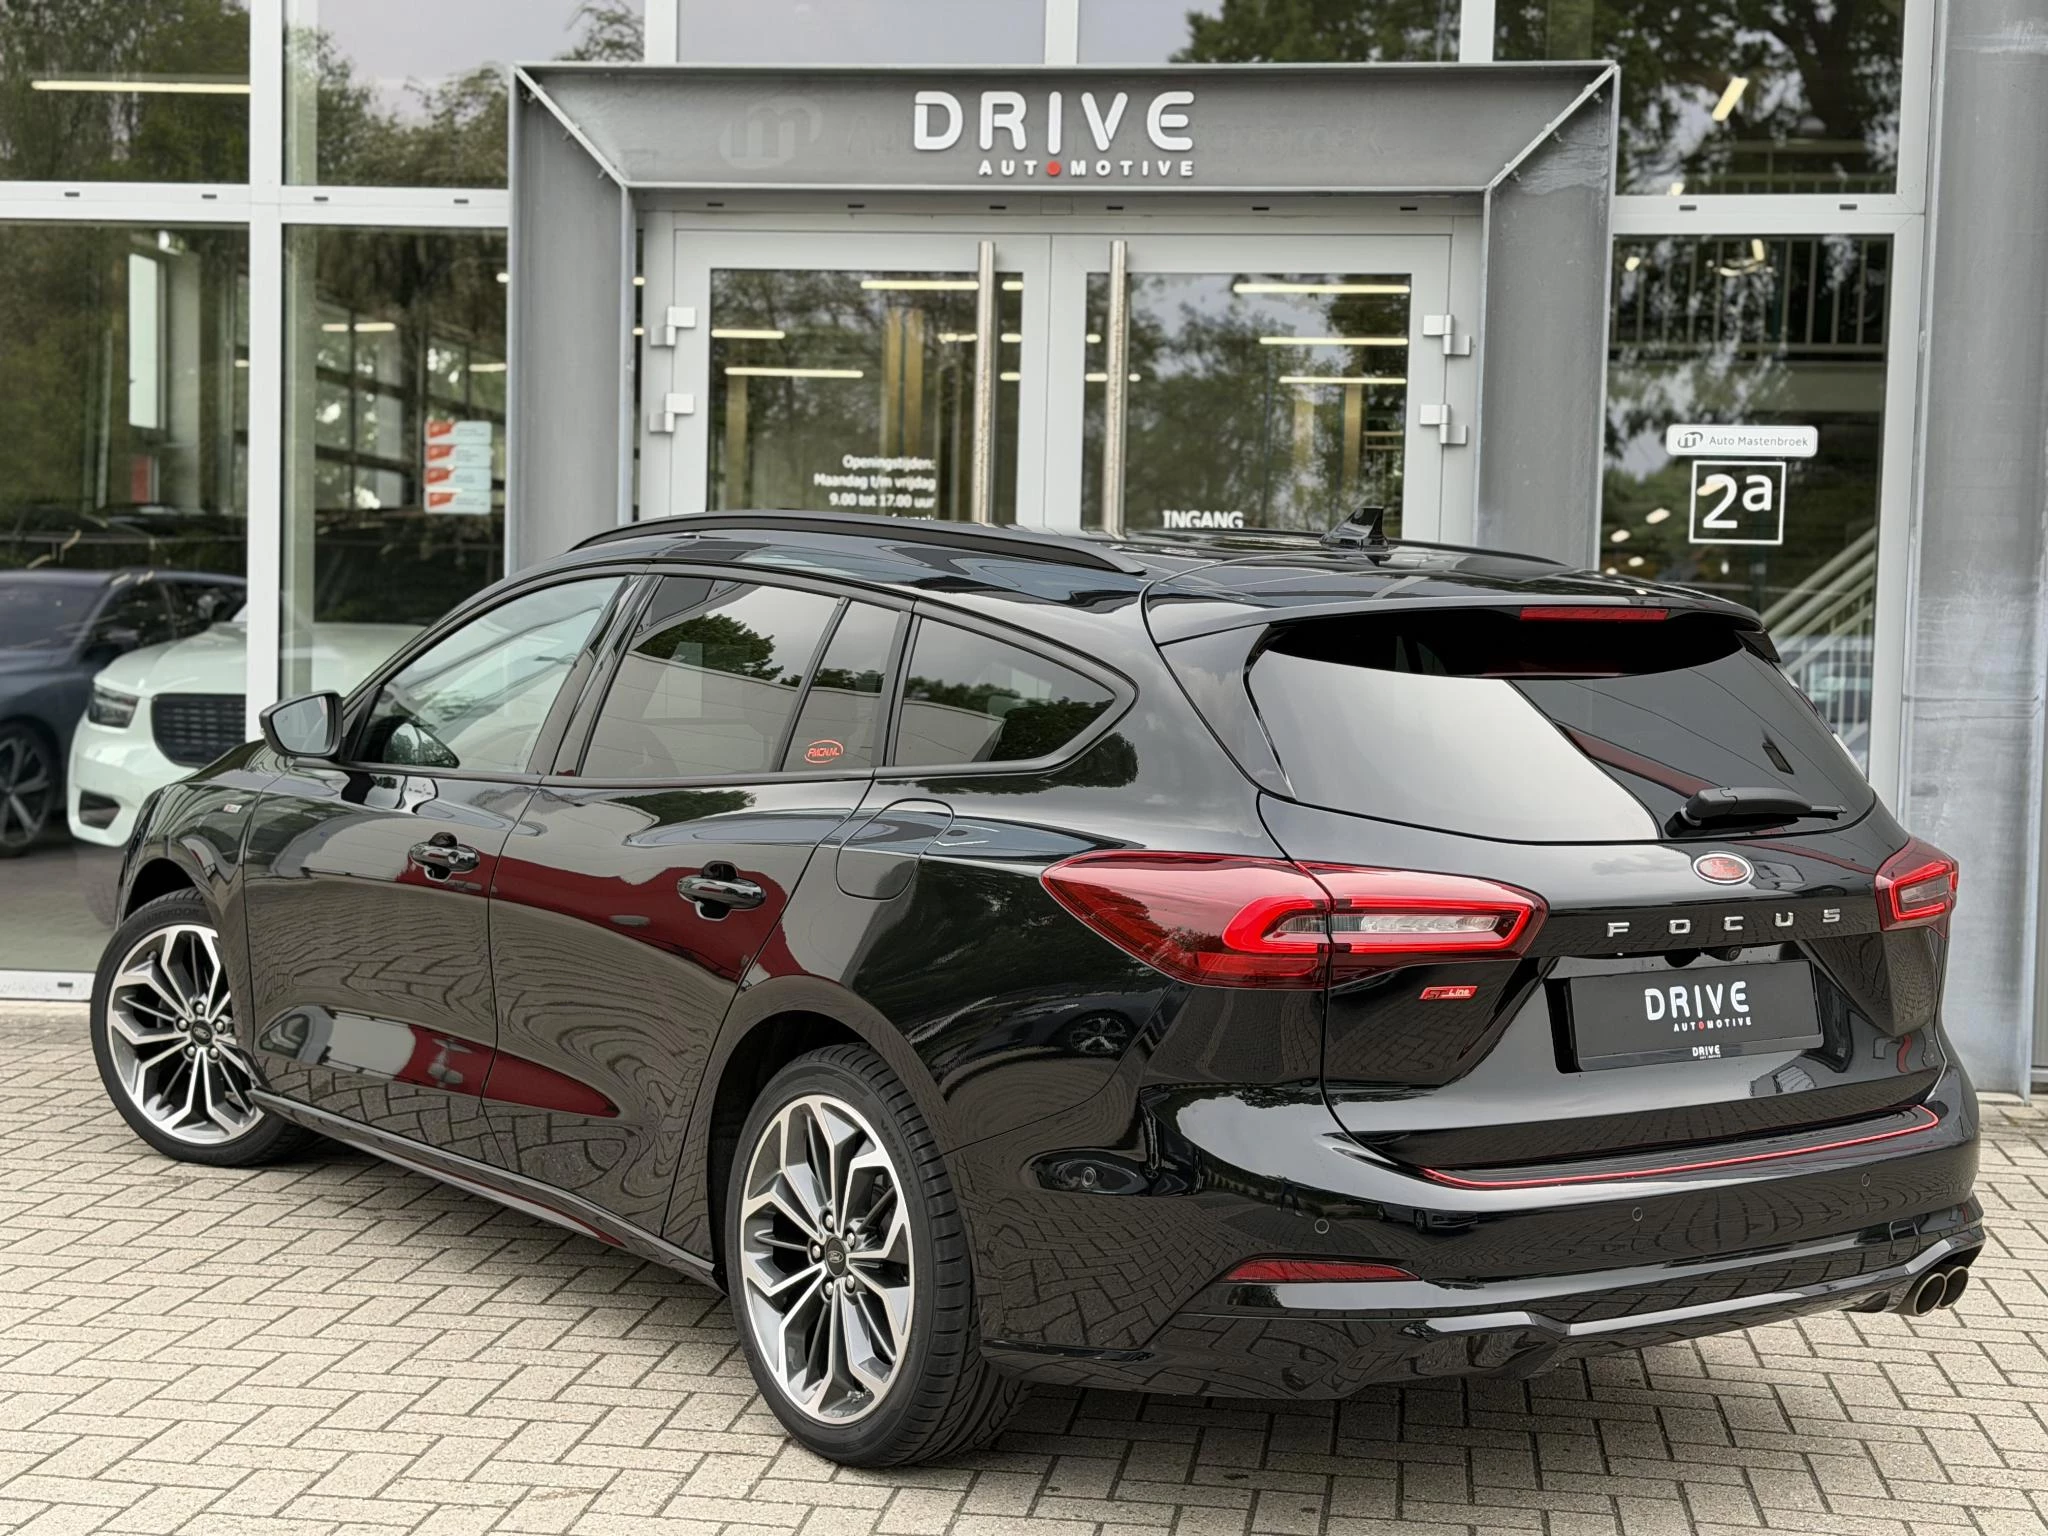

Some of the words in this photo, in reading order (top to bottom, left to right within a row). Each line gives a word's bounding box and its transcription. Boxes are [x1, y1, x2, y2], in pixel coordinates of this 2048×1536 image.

[914, 91, 1195, 155] DRIVE
[1709, 436, 1735, 447] Auto
[1738, 436, 1808, 447] Mastenbroek
[814, 473, 868, 490] Maandag
[1703, 473, 1773, 529] 2a
[1162, 510, 1244, 529] INGANG
[1606, 907, 1842, 938] FOCUS
[1644, 980, 1750, 1021] DRIVE
[1673, 1016, 1752, 1033] AUTOMOTIVE
[1692, 1044, 1721, 1057] DRIVE
